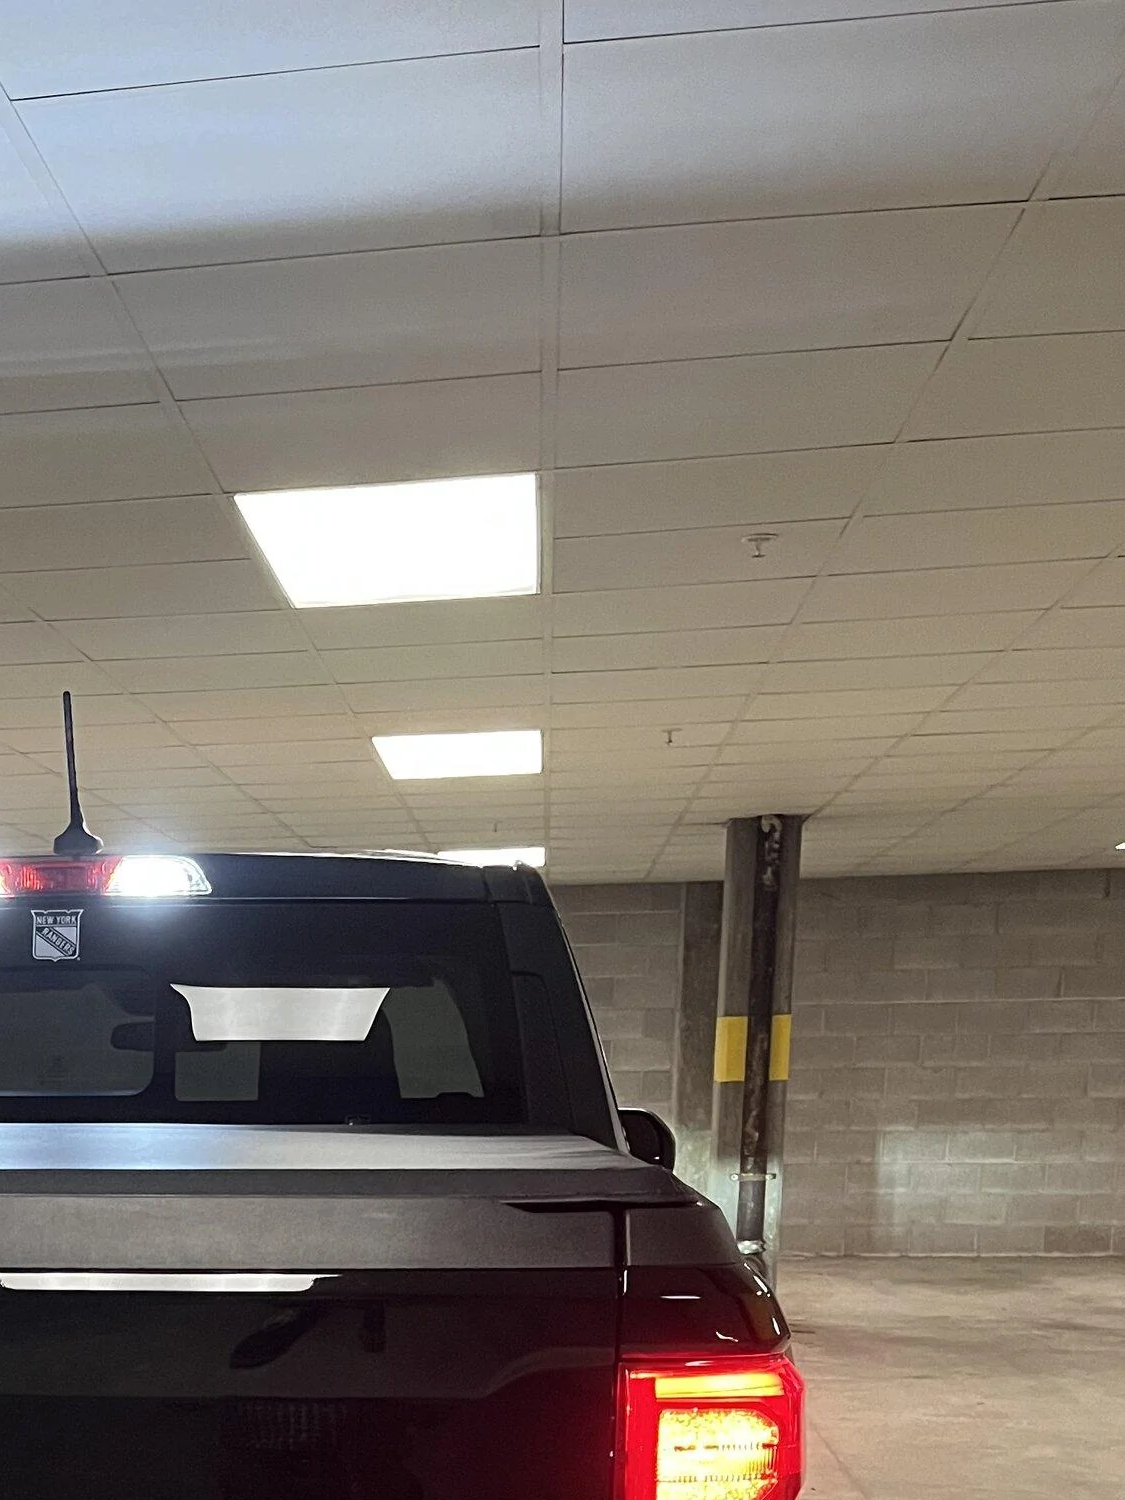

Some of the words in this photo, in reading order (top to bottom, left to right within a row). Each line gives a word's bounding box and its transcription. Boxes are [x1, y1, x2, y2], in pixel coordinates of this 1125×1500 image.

[36, 915, 54, 925] NEW
[56, 915, 77, 925] YORK
[41, 927, 75, 956] RANGERS
